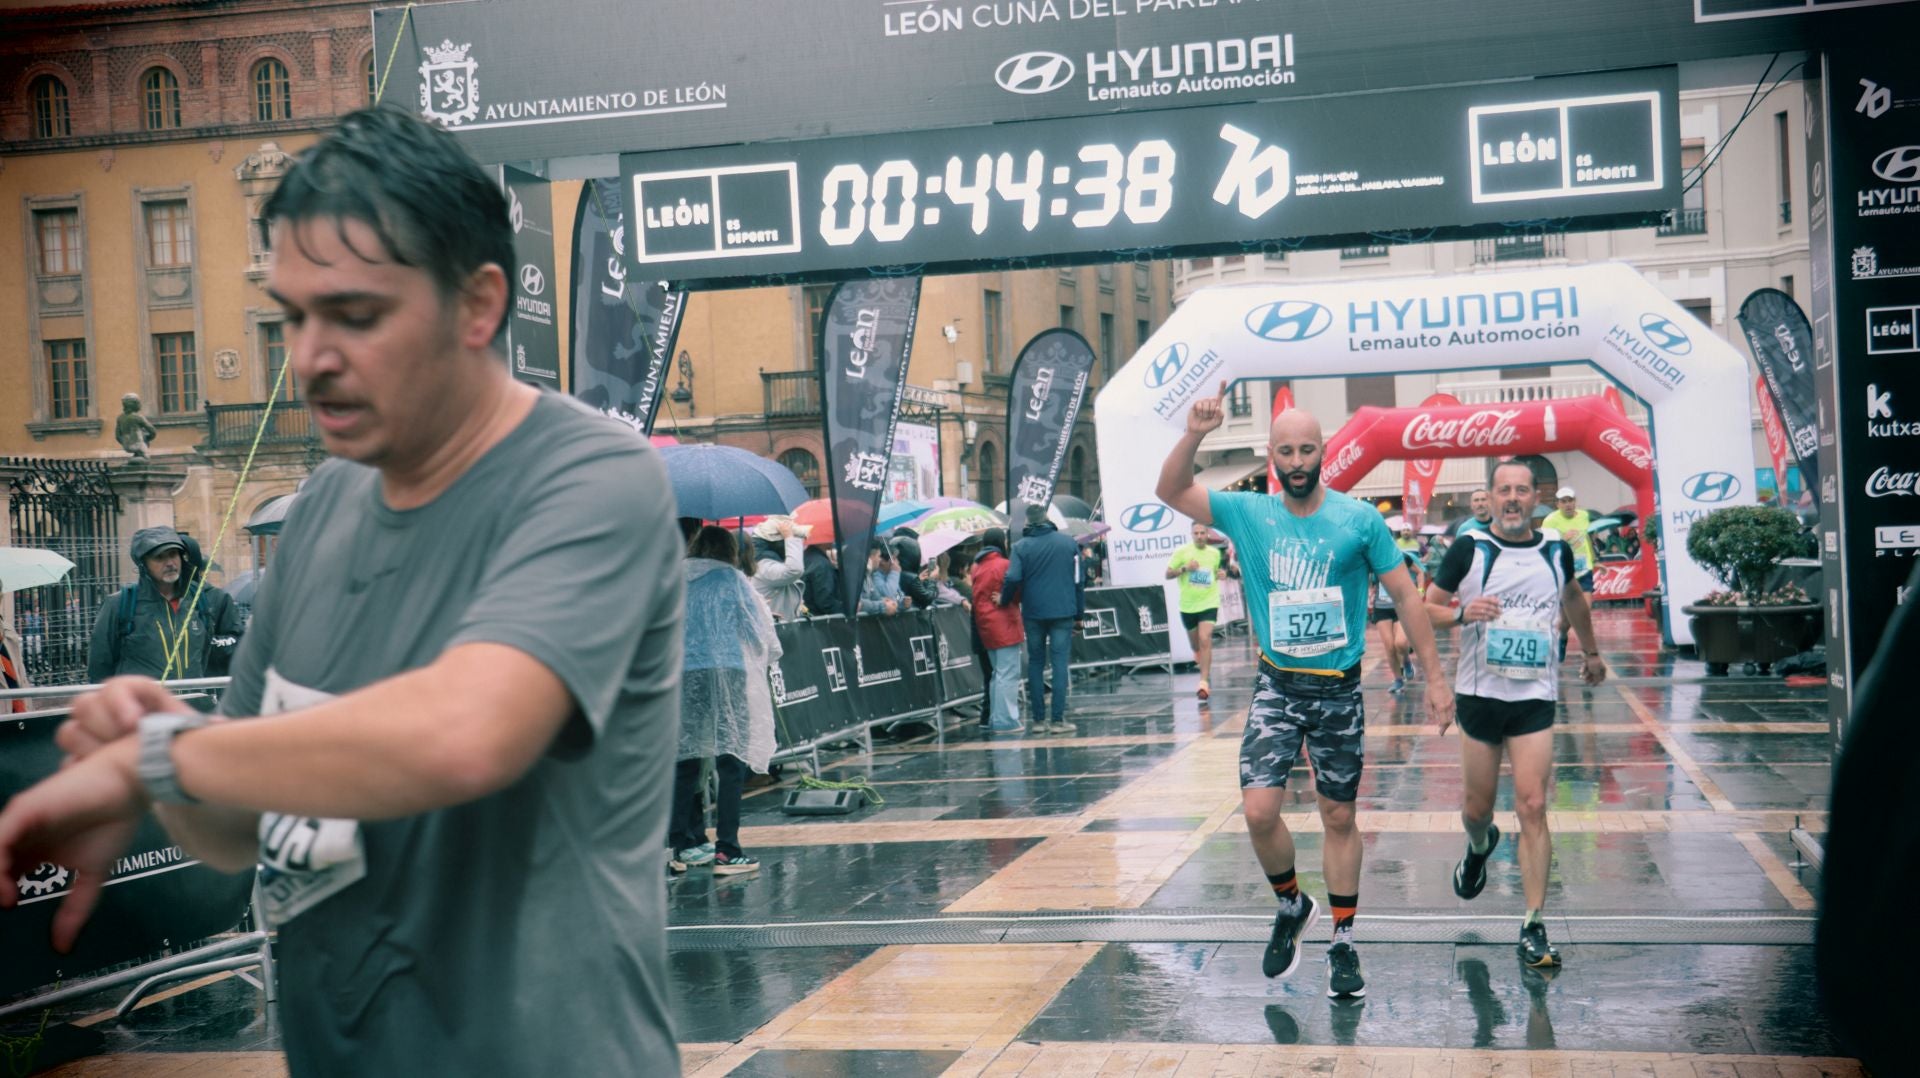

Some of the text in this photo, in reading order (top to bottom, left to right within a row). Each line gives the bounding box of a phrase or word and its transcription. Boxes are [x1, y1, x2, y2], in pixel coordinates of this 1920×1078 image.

[884, 4, 963, 36] LEÓN
[972, 0, 1060, 28] CUNA
[1069, 0, 1127, 20] DEL
[1086, 33, 1295, 84] HYUNDAI
[485, 81, 727, 120] AYUNTAMIENTO DE LEÓN
[1088, 68, 1295, 101] Lemauto Automoción
[1483, 132, 1557, 165] LEÓN
[1576, 165, 1637, 182] DEPORTE
[819, 139, 1176, 246] 00:44:38
[647, 198, 710, 229] LEÓN
[726, 219, 741, 231] ES
[1858, 206, 1900, 217] Lemauto
[727, 229, 779, 245] DEPORTE
[517, 295, 552, 317] HYUNDAI
[1348, 286, 1579, 333] HYUNDAI
[1349, 321, 1580, 352] Lemauto Automoción
[1872, 320, 1912, 337] LEÓN
[638, 292, 677, 415] AYUNTAMIENT
[1609, 324, 1685, 385] HYUNDAI
[1153, 349, 1218, 416] HYUNDAI
[1048, 411, 1074, 480] AYUNTAMIENTO
[1401, 409, 1522, 450] Coca-Cola
[1114, 535, 1187, 553] HYUNDAI
[1289, 611, 1327, 637] 522
[1502, 638, 1537, 660] 249
